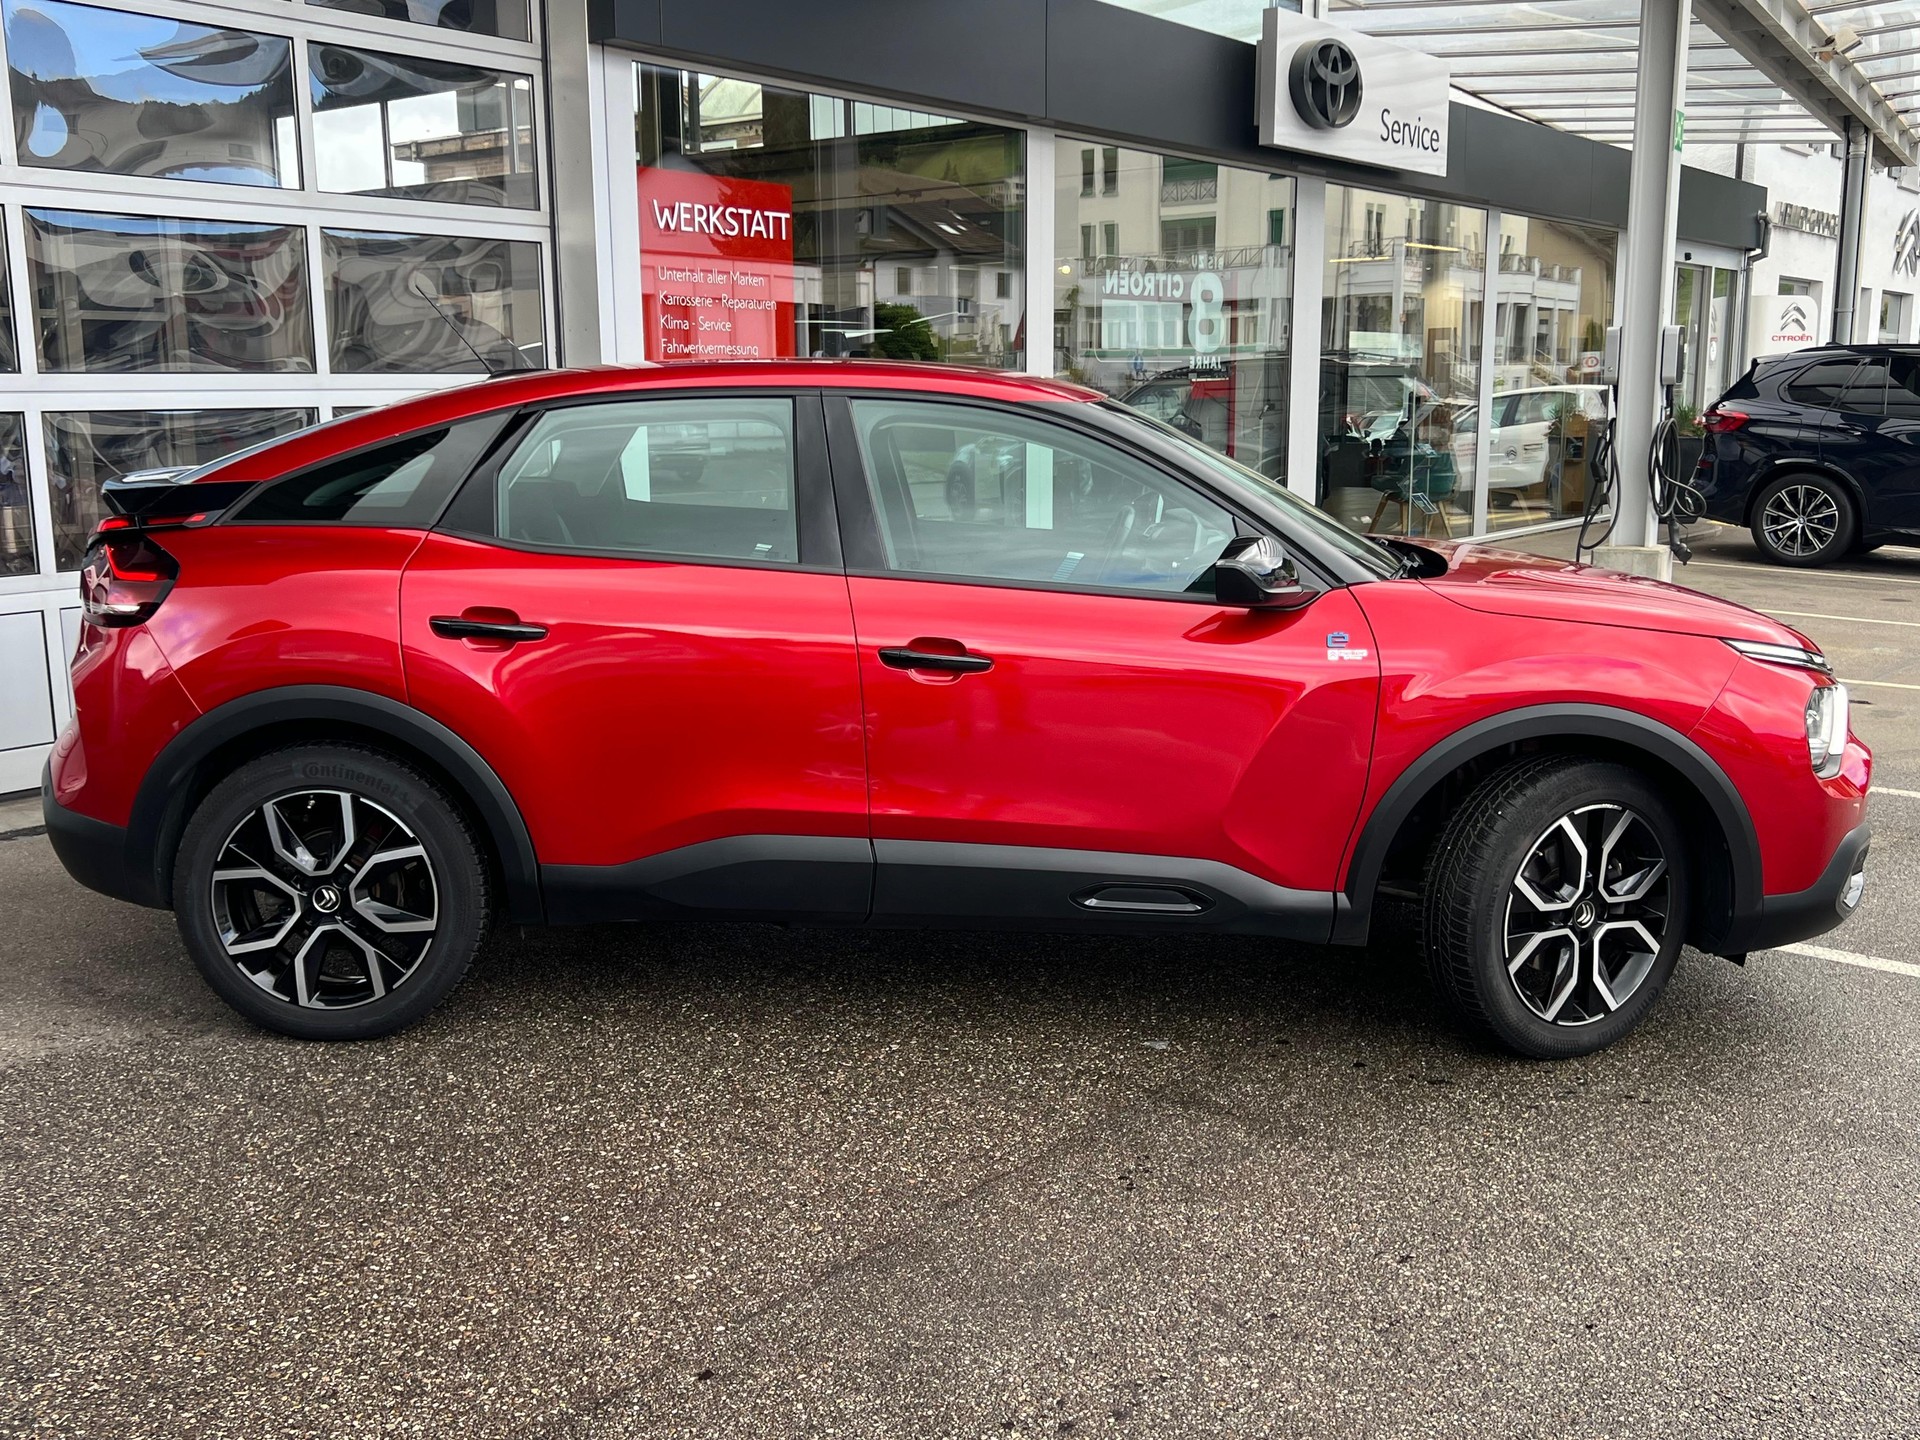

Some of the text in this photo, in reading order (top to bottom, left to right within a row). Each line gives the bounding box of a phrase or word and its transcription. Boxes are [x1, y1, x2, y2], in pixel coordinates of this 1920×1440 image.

[1380, 108, 1440, 152] Service
[653, 199, 790, 240] WERKSTATT
[658, 266, 764, 287] Unterhalt aller Marken
[659, 290, 713, 308] Karrosserie
[721, 293, 777, 312] Reparaturen
[660, 315, 689, 330] Klima
[698, 317, 732, 332] Service
[661, 338, 759, 357] Fahrwerkvermessung
[1771, 333, 1813, 342] CITROËN
[302, 762, 399, 798] Continental
